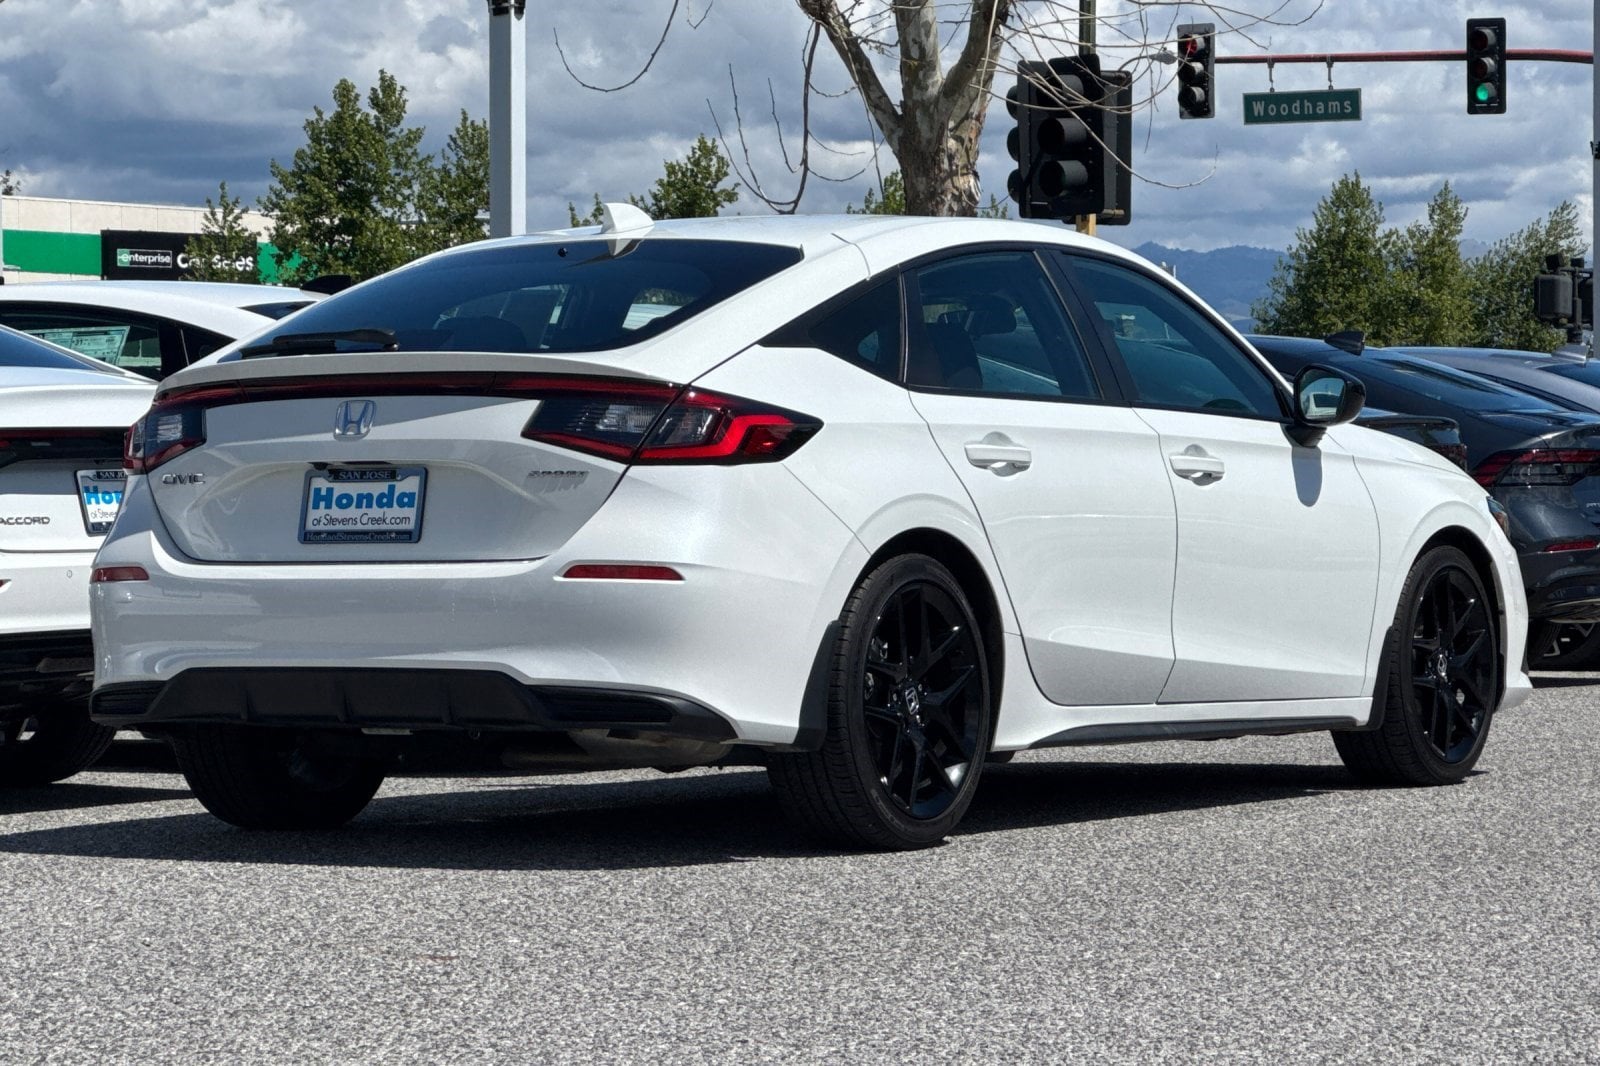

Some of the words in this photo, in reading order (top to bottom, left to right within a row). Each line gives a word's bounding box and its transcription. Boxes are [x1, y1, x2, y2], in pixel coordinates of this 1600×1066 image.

[1252, 100, 1352, 117] Woodhams
[118, 253, 171, 264] enterprise
[162, 473, 206, 484] CIVIC
[339, 471, 361, 479] SAN
[363, 471, 391, 479] JOSE
[312, 484, 416, 510] Honda
[312, 516, 322, 527] of
[323, 514, 358, 526] Stevens
[360, 511, 411, 526] Creek.com
